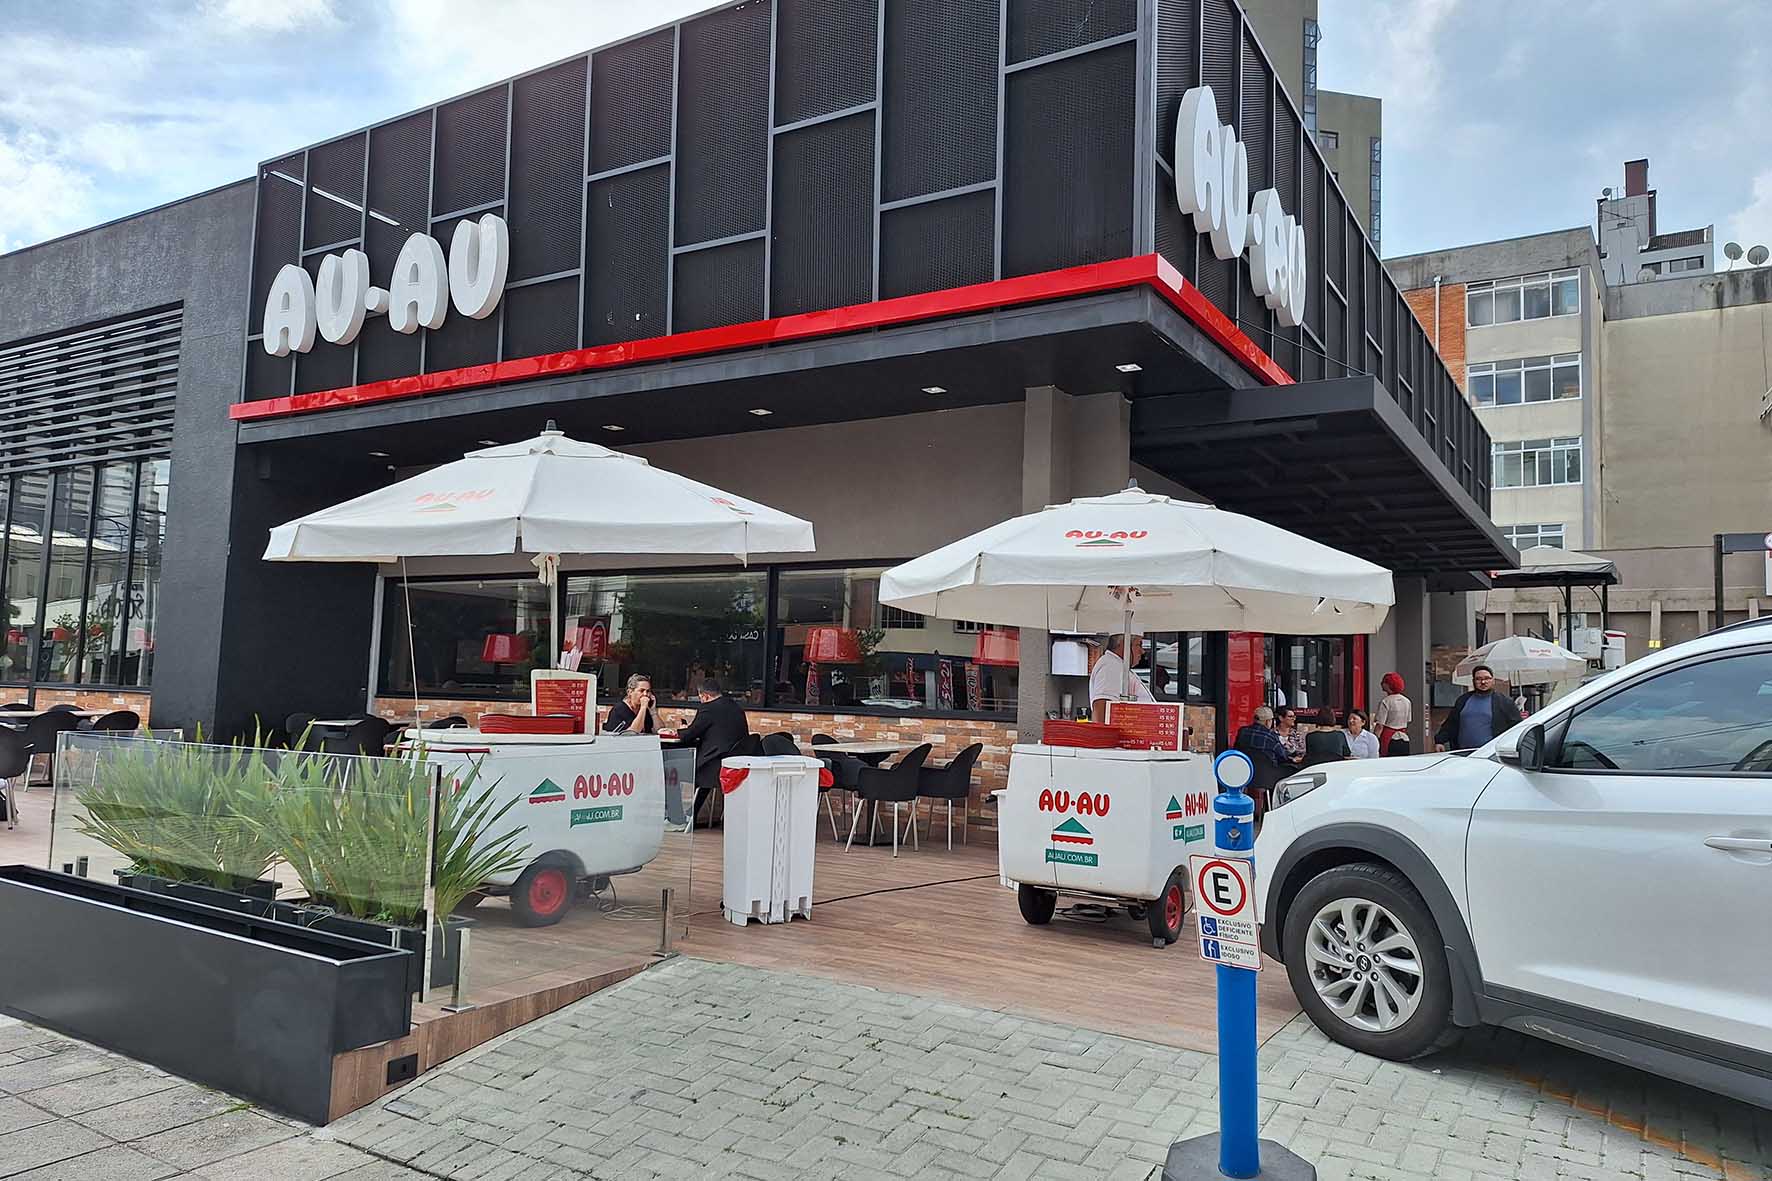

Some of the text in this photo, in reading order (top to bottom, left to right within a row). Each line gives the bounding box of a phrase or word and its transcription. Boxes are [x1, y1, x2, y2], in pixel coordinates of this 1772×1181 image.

[1212, 871, 1232, 905] E
[1217, 918, 1252, 930] EXCLUSIVO
[1218, 925, 1253, 937] DEFICIENTE
[1220, 944, 1255, 956] EXCLUSIVO
[1221, 951, 1240, 960] IDOSO
